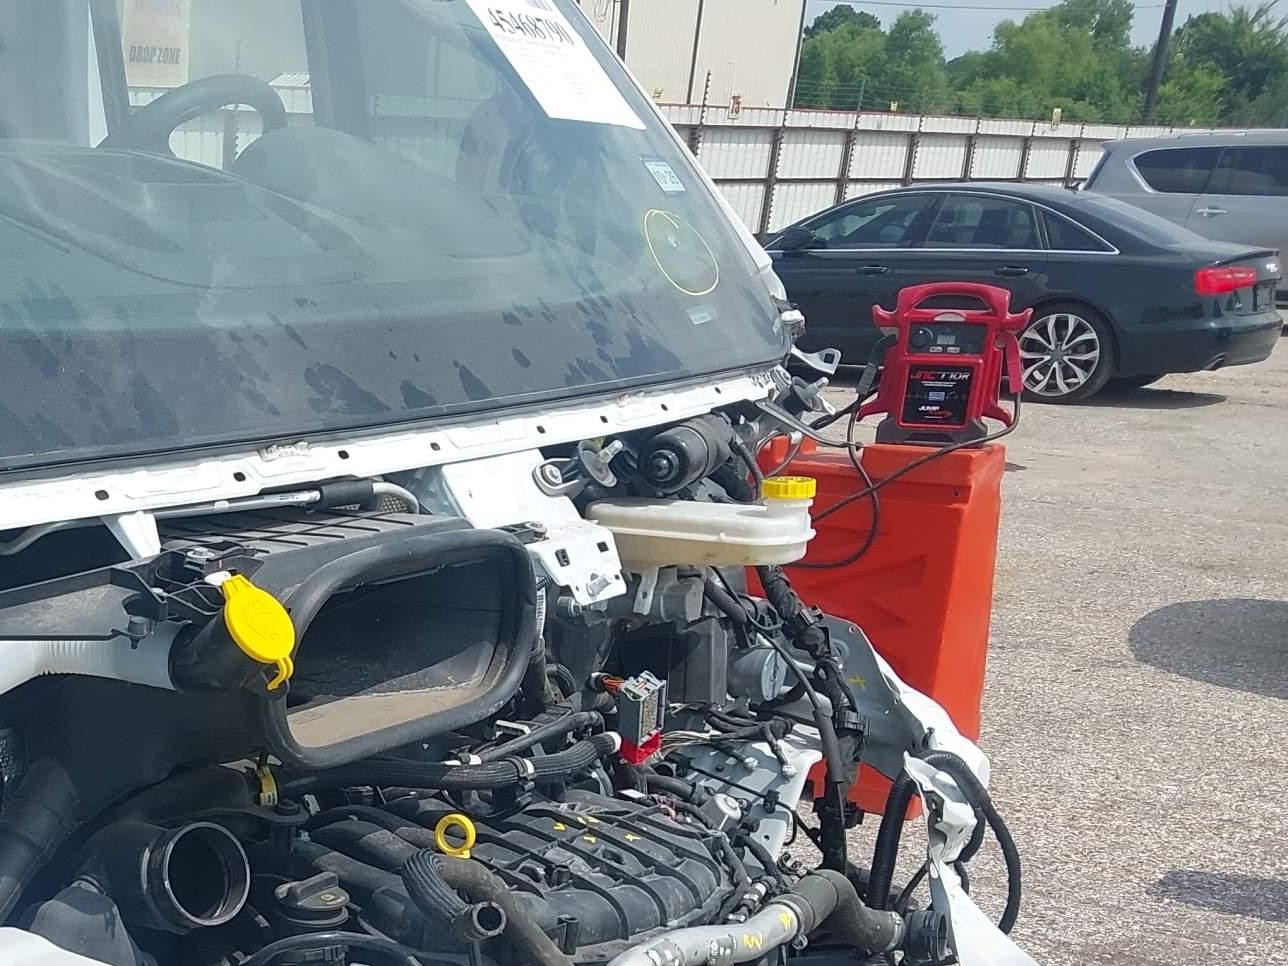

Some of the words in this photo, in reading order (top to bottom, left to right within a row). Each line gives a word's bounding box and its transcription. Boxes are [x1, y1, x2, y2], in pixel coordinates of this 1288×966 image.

[487, 8, 575, 46] 45468790
[129, 46, 157, 64] DROP
[157, 47, 181, 65] ZONE
